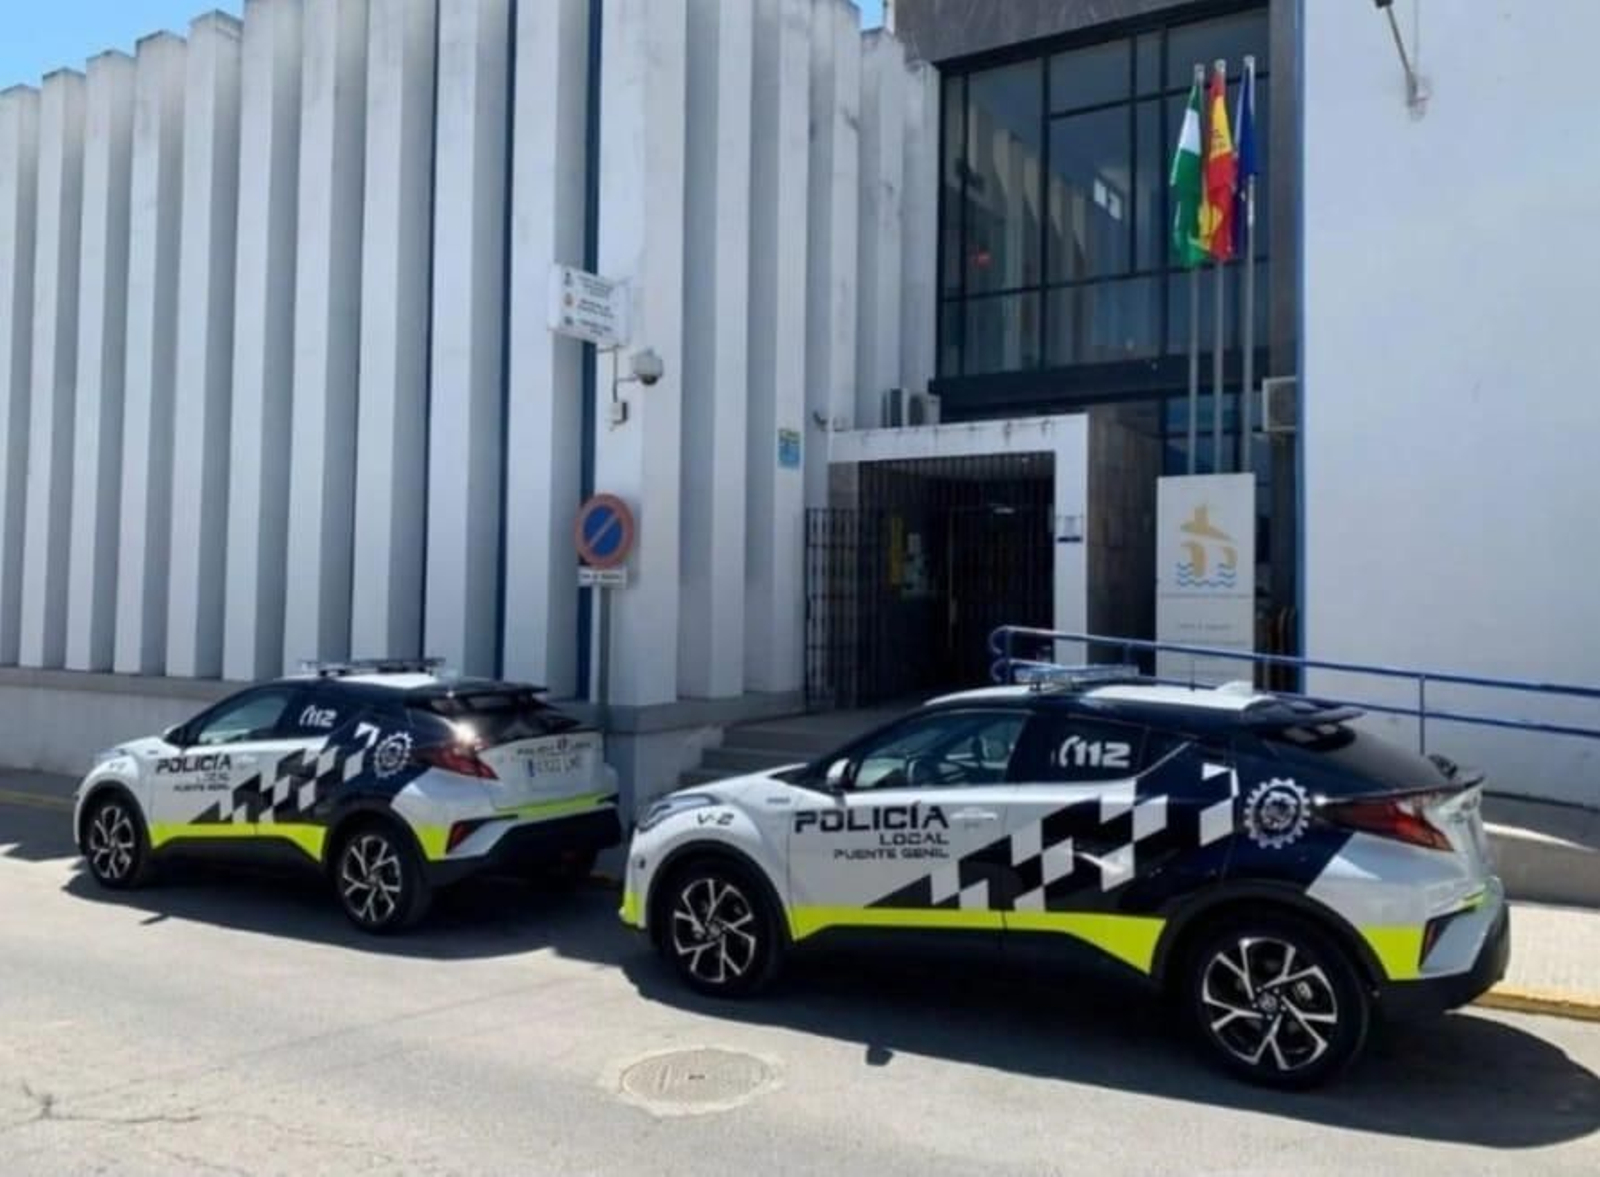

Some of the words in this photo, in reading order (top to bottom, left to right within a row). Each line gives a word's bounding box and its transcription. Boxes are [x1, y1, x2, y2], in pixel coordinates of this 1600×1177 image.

[1072, 739, 1131, 767] 112
[795, 801, 949, 833] POLICÍA
[879, 832, 949, 845] LOCAL
[834, 849, 897, 859] PUENTE
[902, 848, 949, 858] GENIL
